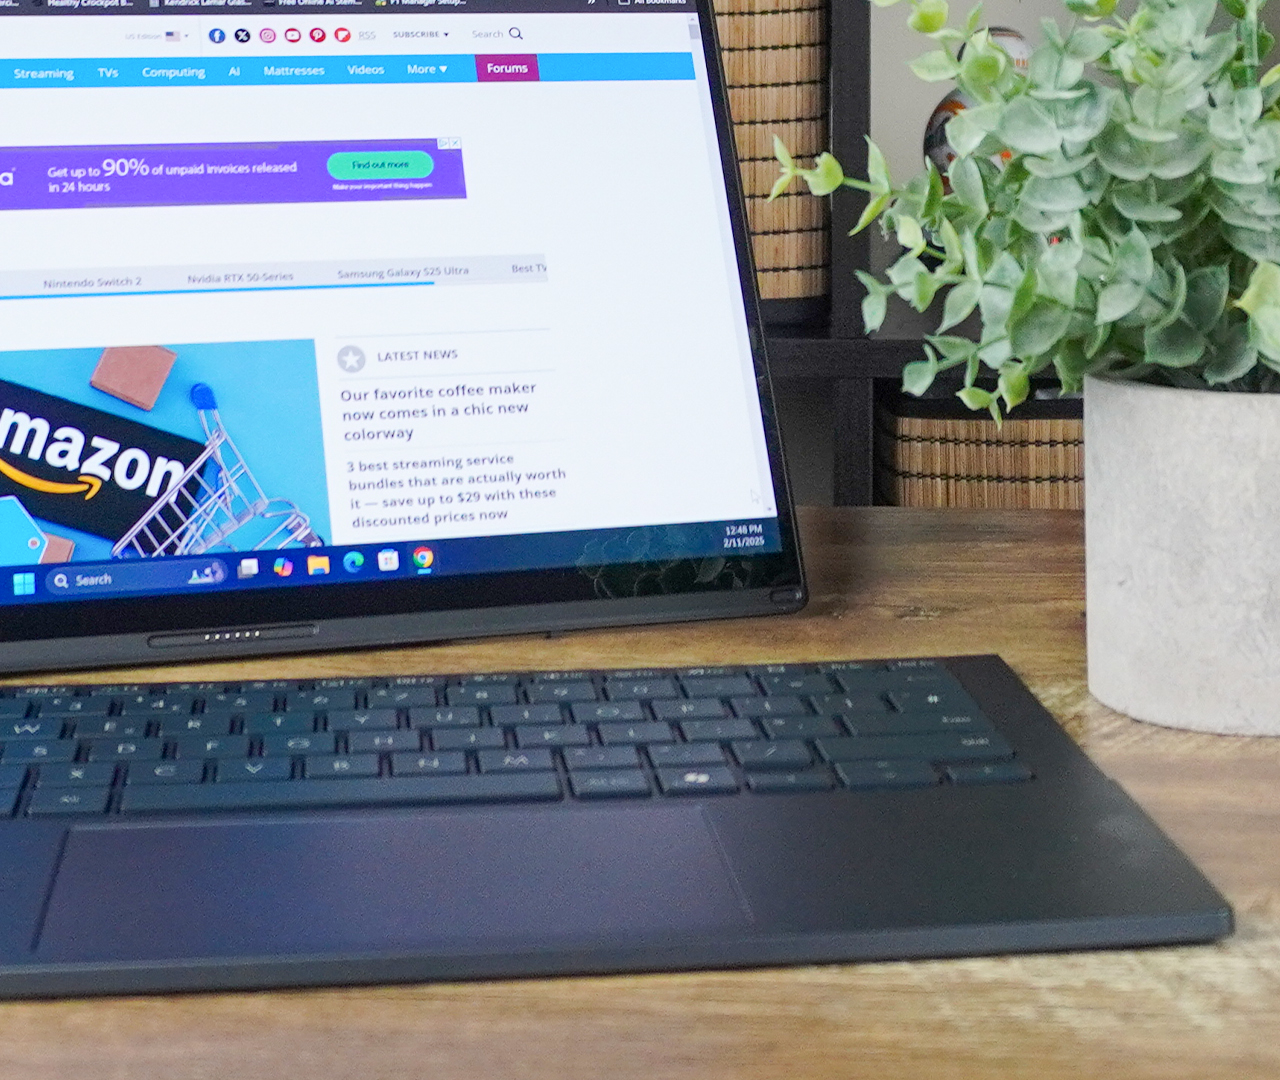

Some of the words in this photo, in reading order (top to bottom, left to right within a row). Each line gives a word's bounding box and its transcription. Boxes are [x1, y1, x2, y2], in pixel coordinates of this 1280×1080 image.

[358, 31, 376, 41] RSS
[392, 31, 440, 39] SUBSCRIBE
[472, 29, 504, 39] Search
[14, 68, 75, 82] Streaming
[97, 67, 119, 79] TVs
[142, 66, 206, 80] Computing
[263, 65, 326, 77] Mattresses
[347, 64, 385, 76] Videos
[407, 63, 436, 75] More
[487, 62, 529, 75] Forums
[47, 166, 68, 178] Get
[70, 167, 87, 180] up
[88, 166, 100, 177] to
[102, 158, 150, 177] 90%
[151, 165, 164, 176] of
[166, 163, 205, 177] unpaid
[206, 163, 251, 175] invoices
[252, 161, 298, 174] released
[352, 160, 370, 170] Find
[371, 161, 385, 169] out
[387, 161, 410, 169] more
[48, 182, 59, 193] in
[61, 182, 76, 193] 24
[78, 181, 111, 193] hours
[337, 268, 385, 281] Samsung
[387, 267, 422, 279] Galaxy
[444, 265, 470, 276] Ultra
[511, 264, 533, 274] Best
[43, 278, 95, 290] Nintendo
[97, 276, 133, 288] Switch
[135, 276, 143, 286] 2
[187, 274, 221, 285] Nvidia
[377, 350, 420, 363] LATEST
[423, 349, 459, 361] NEWS
[340, 389, 369, 402] Our
[373, 385, 435, 401] favorite
[438, 384, 485, 398] coffee
[489, 382, 537, 396] maker
[342, 410, 375, 422] now
[379, 407, 428, 420] comes
[432, 404, 447, 418] in
[450, 406, 460, 417] a
[463, 403, 494, 416] chic
[497, 401, 530, 414] new
[344, 427, 415, 443] colorway
[346, 461, 356, 473] 3
[358, 459, 389, 472] best
[392, 456, 464, 471] streaming
[466, 453, 515, 466] service
[349, 477, 405, 491] bundles
[408, 475, 438, 489] that
[441, 474, 464, 486] are
[468, 470, 522, 485] actually
[525, 468, 567, 481] worth
[350, 497, 361, 510] it
[382, 495, 414, 508] save
[417, 495, 436, 508] up
[439, 493, 453, 505] to
[457, 490, 482, 505] $29
[484, 489, 516, 502] with
[519, 487, 557, 500] these
[352, 513, 431, 529] discounted
[434, 511, 476, 528] prices
[479, 509, 509, 521] now
[749, 523, 763, 534] PM
[75, 571, 112, 587] Search
